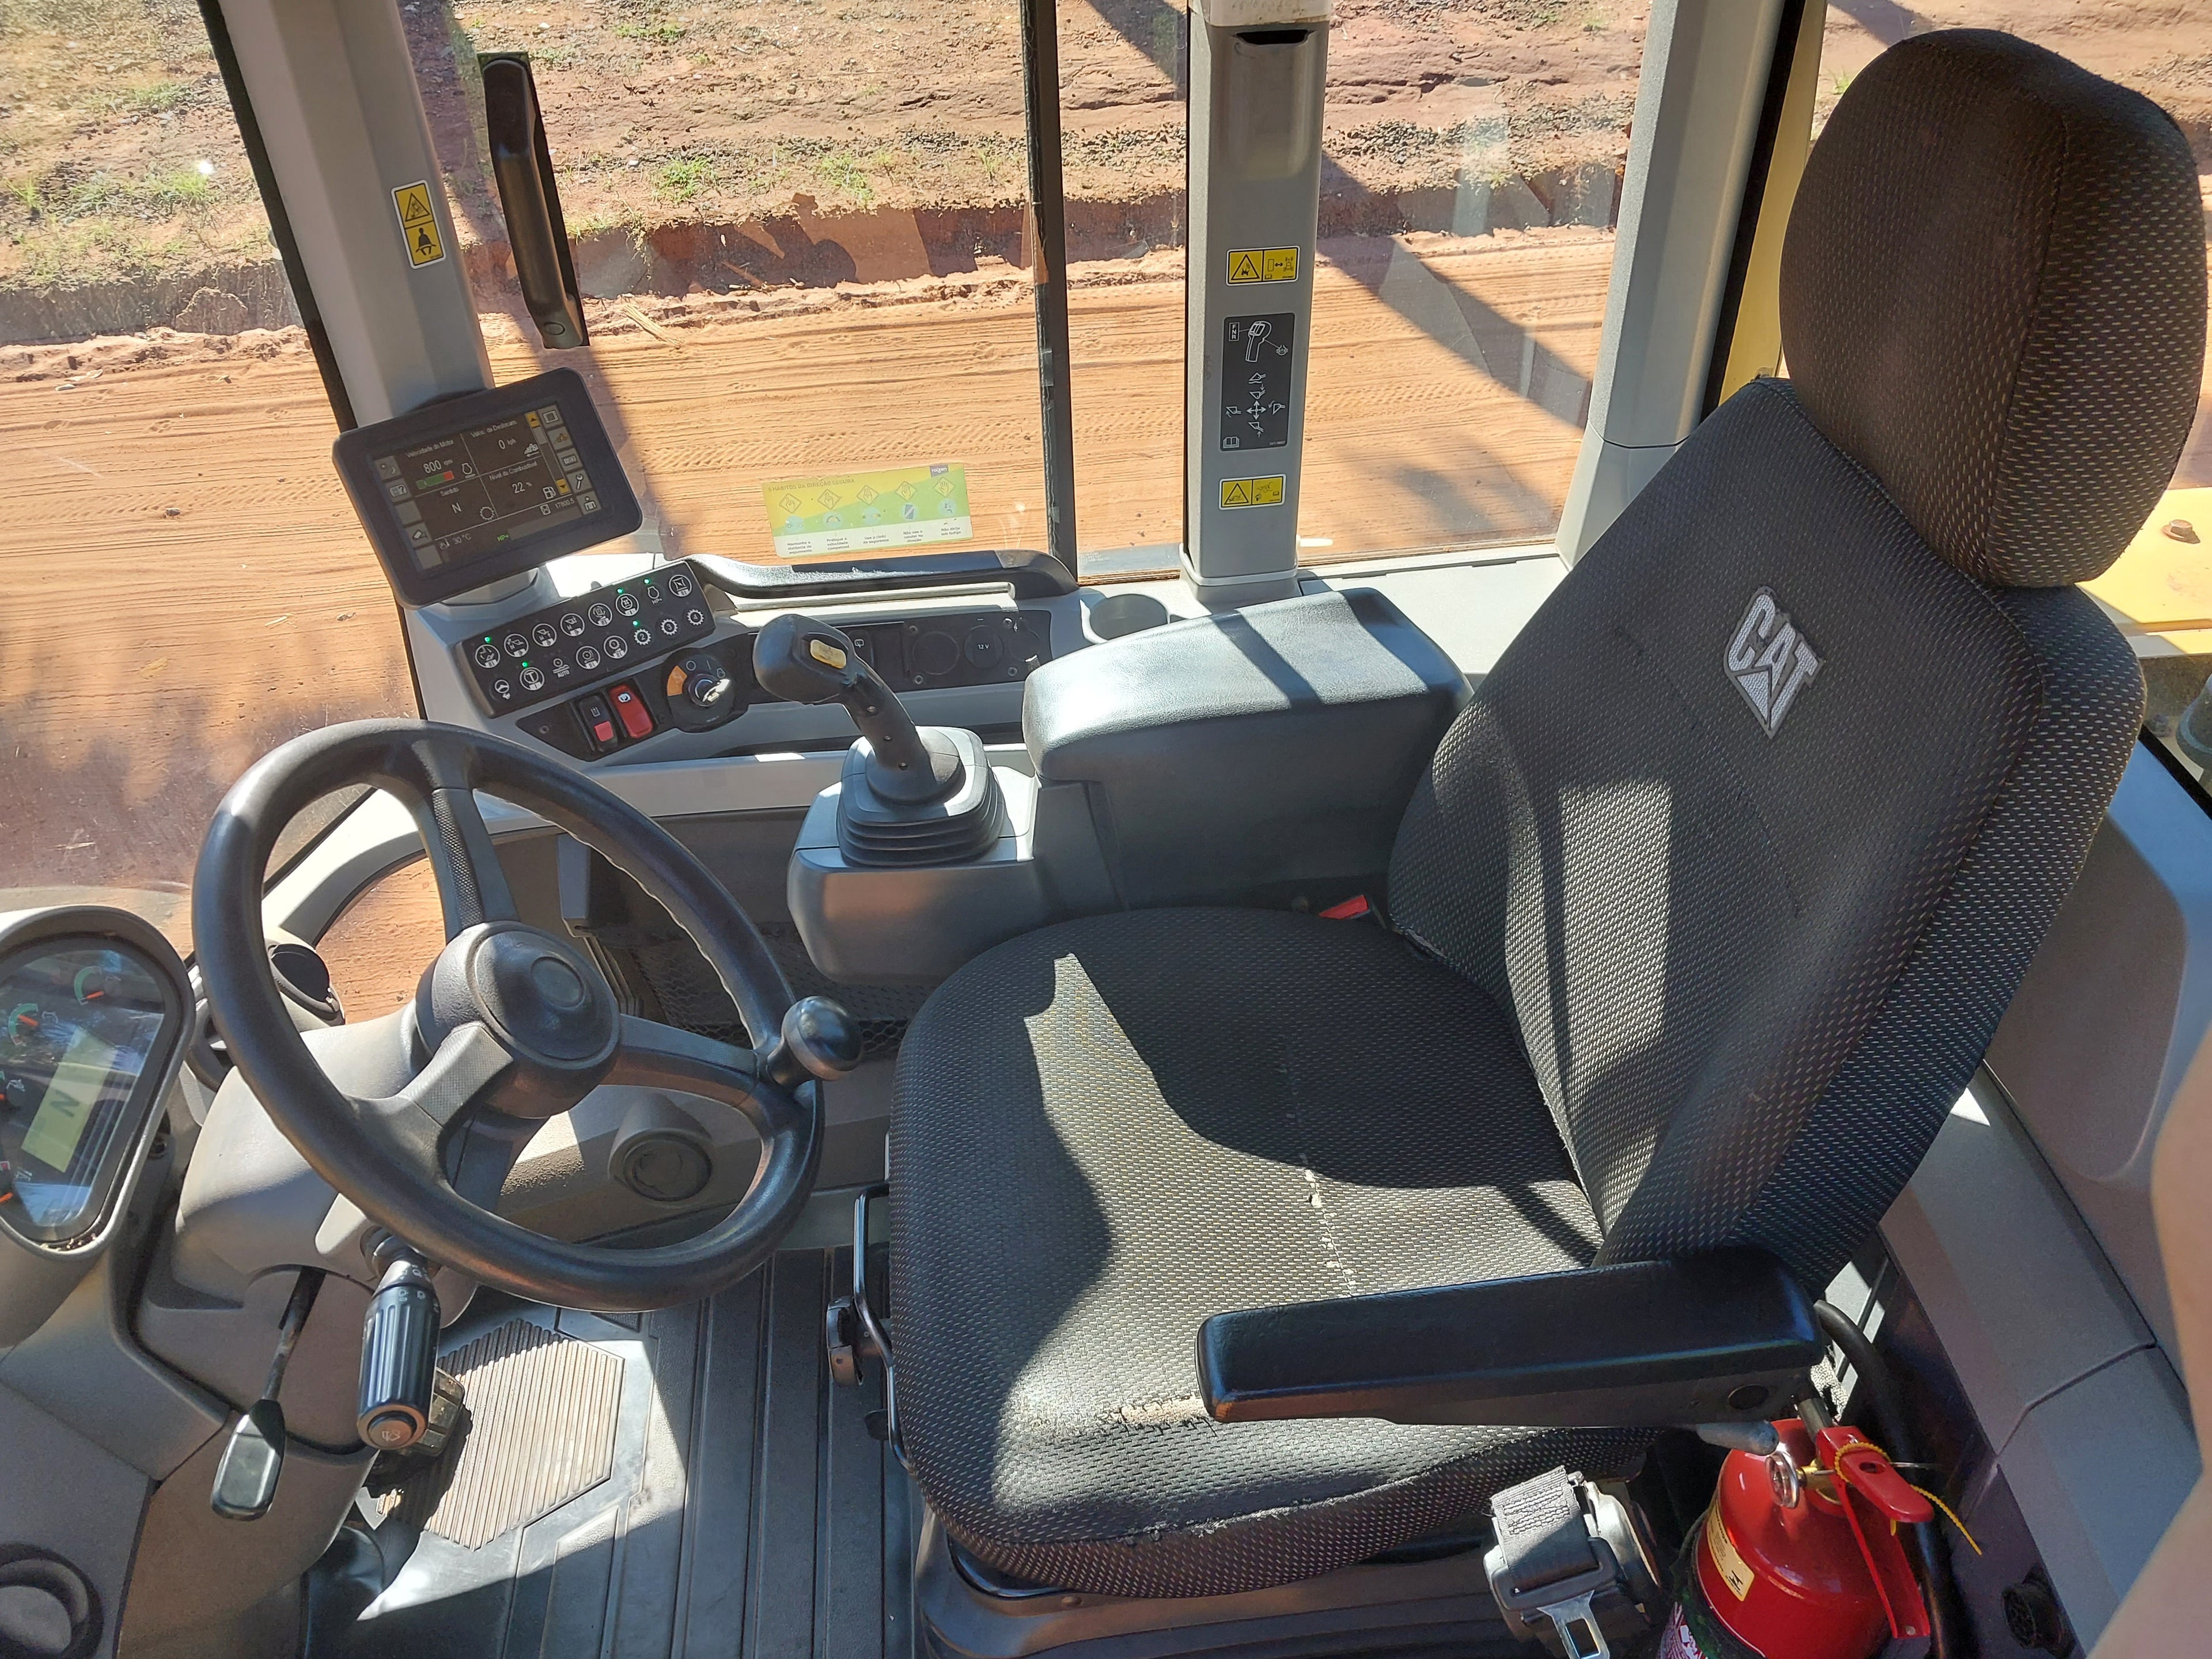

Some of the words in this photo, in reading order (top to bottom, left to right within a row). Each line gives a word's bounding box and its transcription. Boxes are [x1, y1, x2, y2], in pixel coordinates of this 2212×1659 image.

[498, 440, 506, 449] 0
[423, 460, 442, 473] 800
[512, 482, 525, 494] 22
[452, 502, 462, 513] N
[1728, 593, 1819, 730] CAT
[557, 669, 570, 678] AUTO
